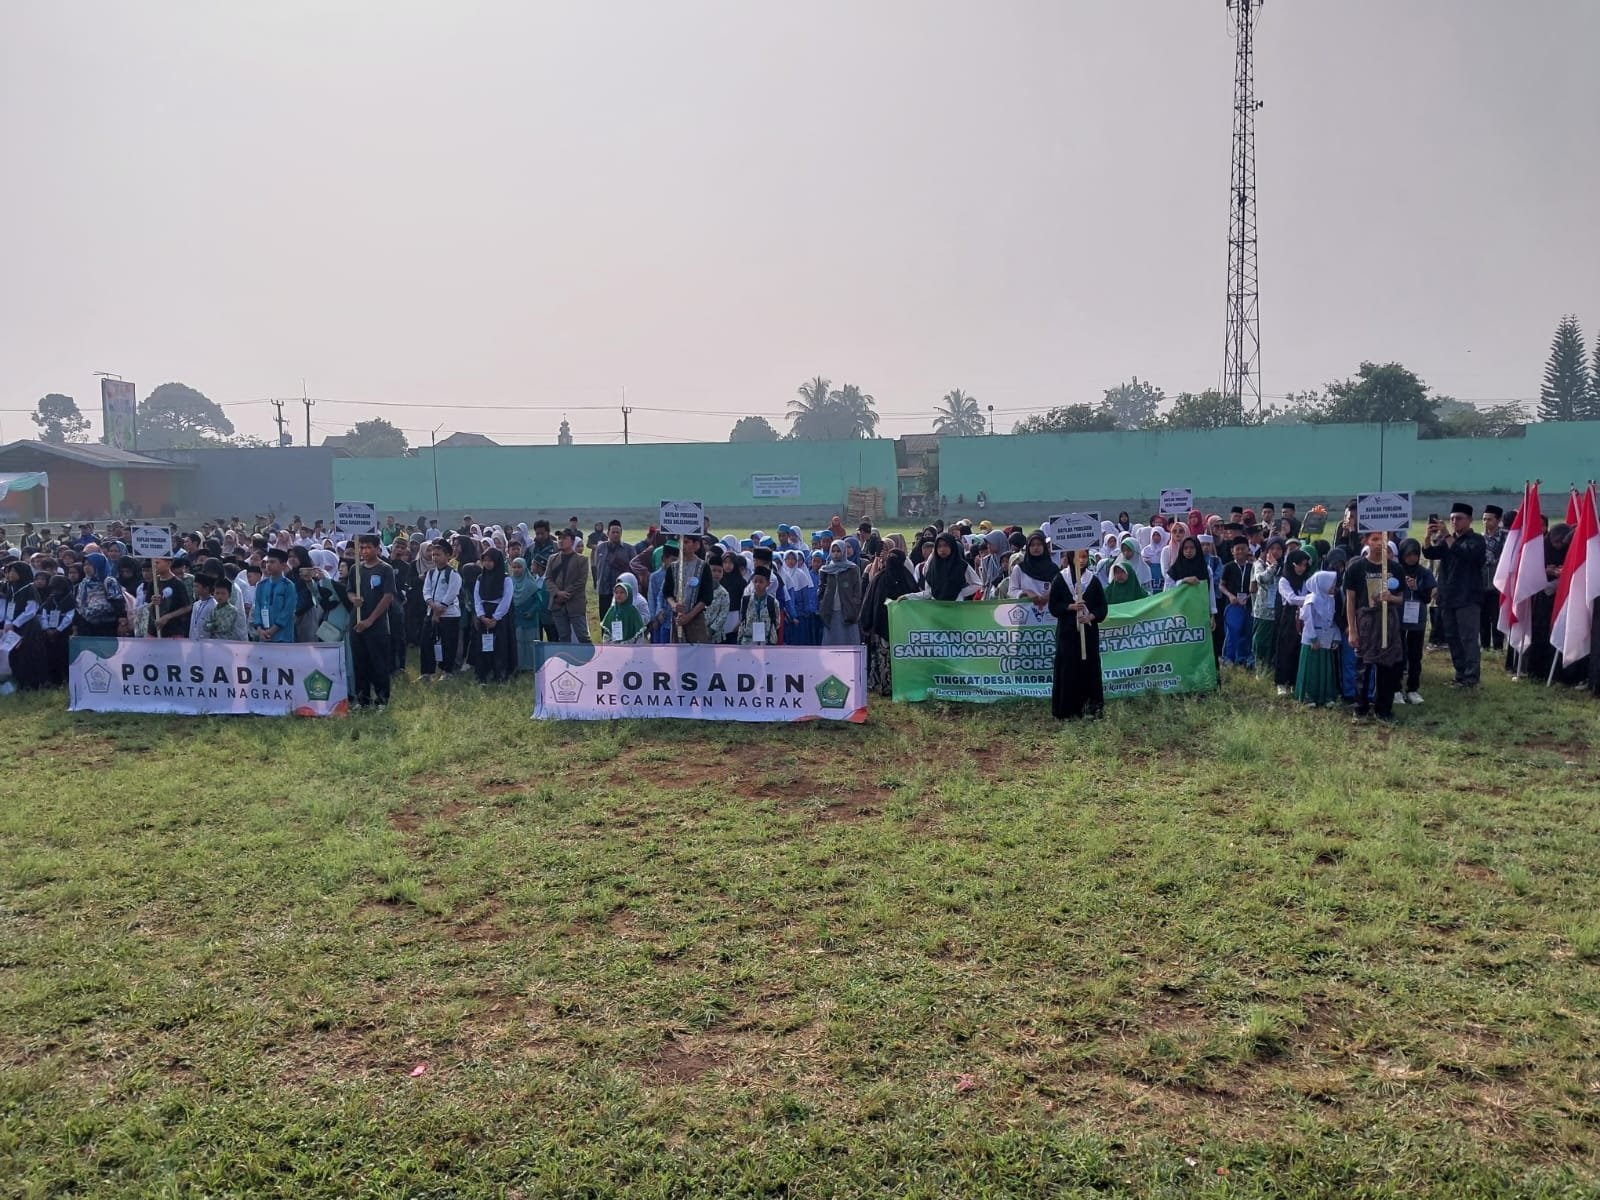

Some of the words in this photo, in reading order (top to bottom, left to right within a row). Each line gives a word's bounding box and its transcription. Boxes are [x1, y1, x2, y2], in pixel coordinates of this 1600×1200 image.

[909, 631, 962, 644] PEKAN
[963, 631, 1008, 644] OLAH
[1010, 629, 1056, 643] RAGA
[1098, 626, 1130, 638] SENI
[1132, 616, 1187, 635] ANTAR
[894, 643, 949, 658] SANTRI
[951, 643, 1041, 657] MADRASAH
[1110, 628, 1205, 651] TAKMILIYAH
[121, 663, 295, 686] PORSADIN
[596, 671, 805, 693] PORSADIN
[934, 675, 981, 685] TINGKAT
[982, 675, 1012, 685] DESA
[1014, 675, 1053, 684] NAGRA
[1103, 667, 1142, 679] TAHUN
[1143, 663, 1173, 675] 2024
[123, 684, 217, 699] KECAMATAN
[227, 687, 294, 701] NAGRAK
[596, 694, 713, 707] KECAMATAN
[725, 695, 803, 709] NAGRAK
